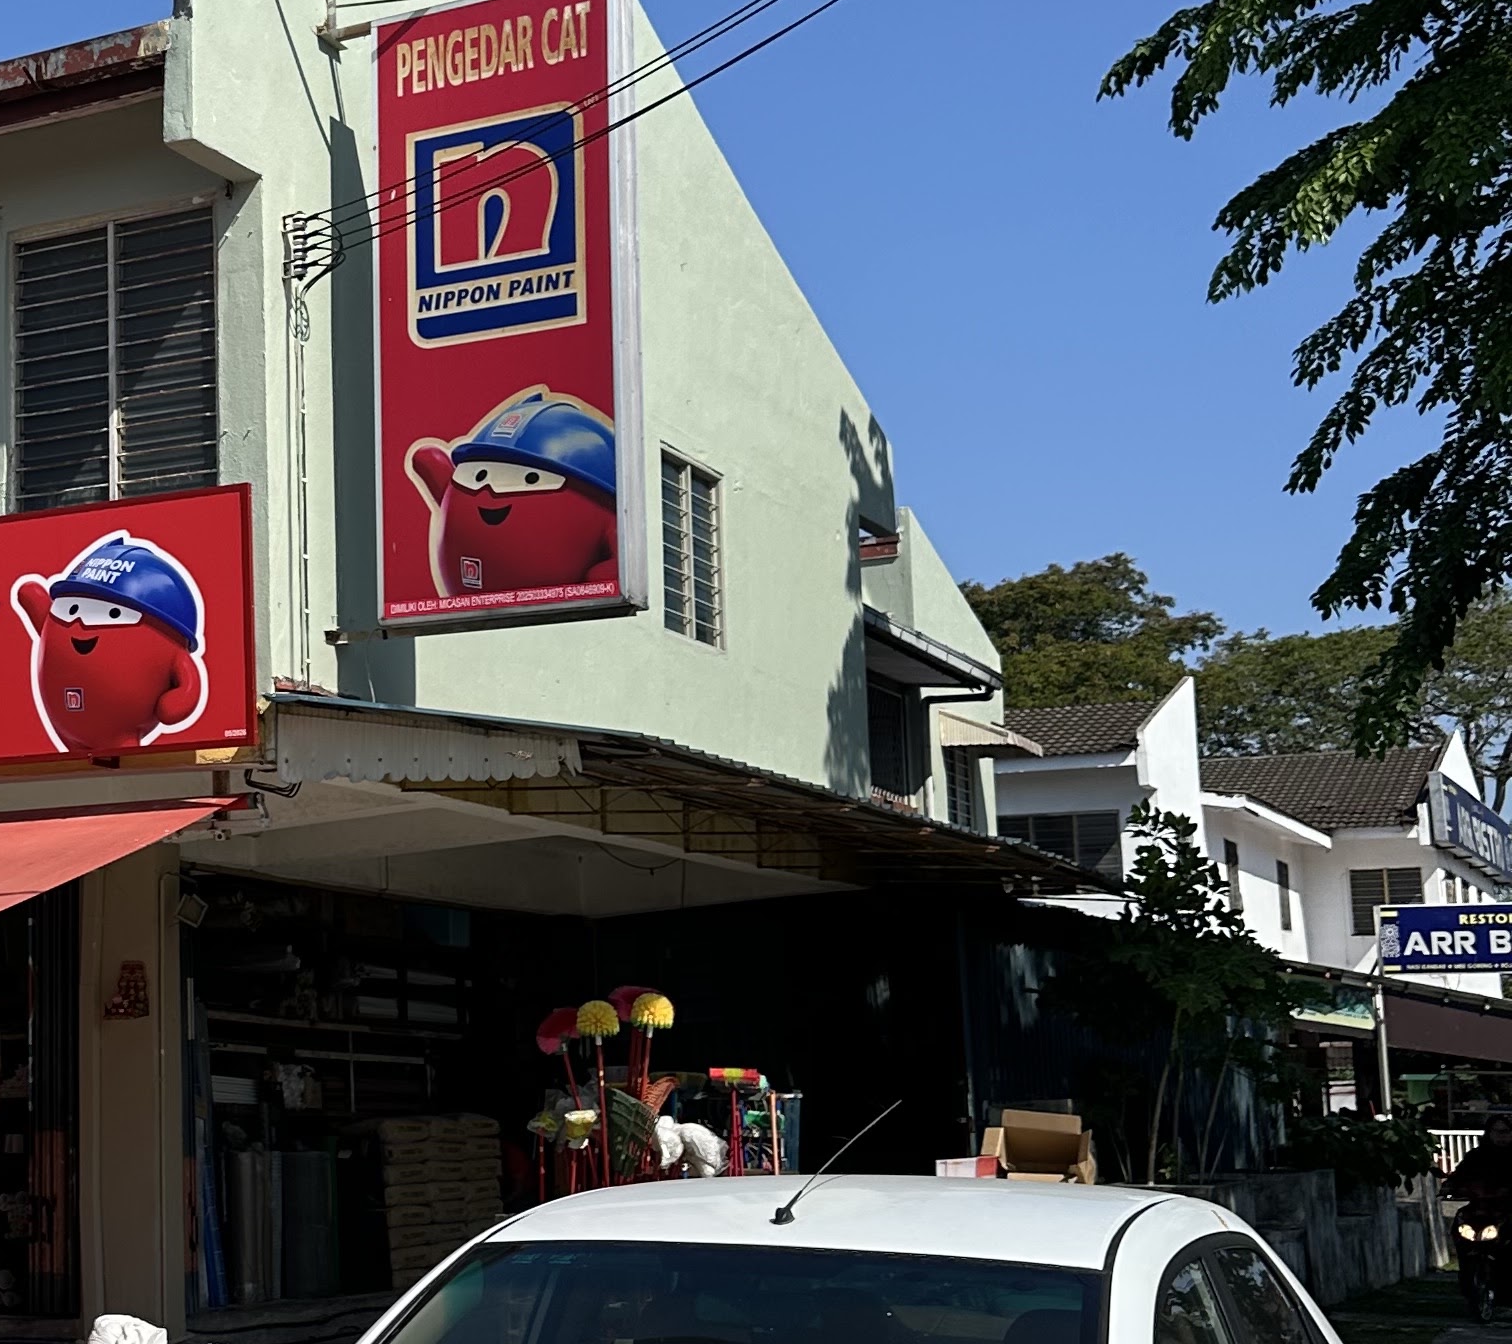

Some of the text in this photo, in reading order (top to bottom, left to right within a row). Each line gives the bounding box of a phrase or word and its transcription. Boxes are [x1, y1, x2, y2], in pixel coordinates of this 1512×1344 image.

[396, 1, 591, 97] PENGEDAR CAT
[417, 269, 576, 313] NIPPON PAINT
[81, 567, 122, 584] PAINT
[85, 558, 136, 573] NIPPON
[1403, 930, 1477, 956] ARR
